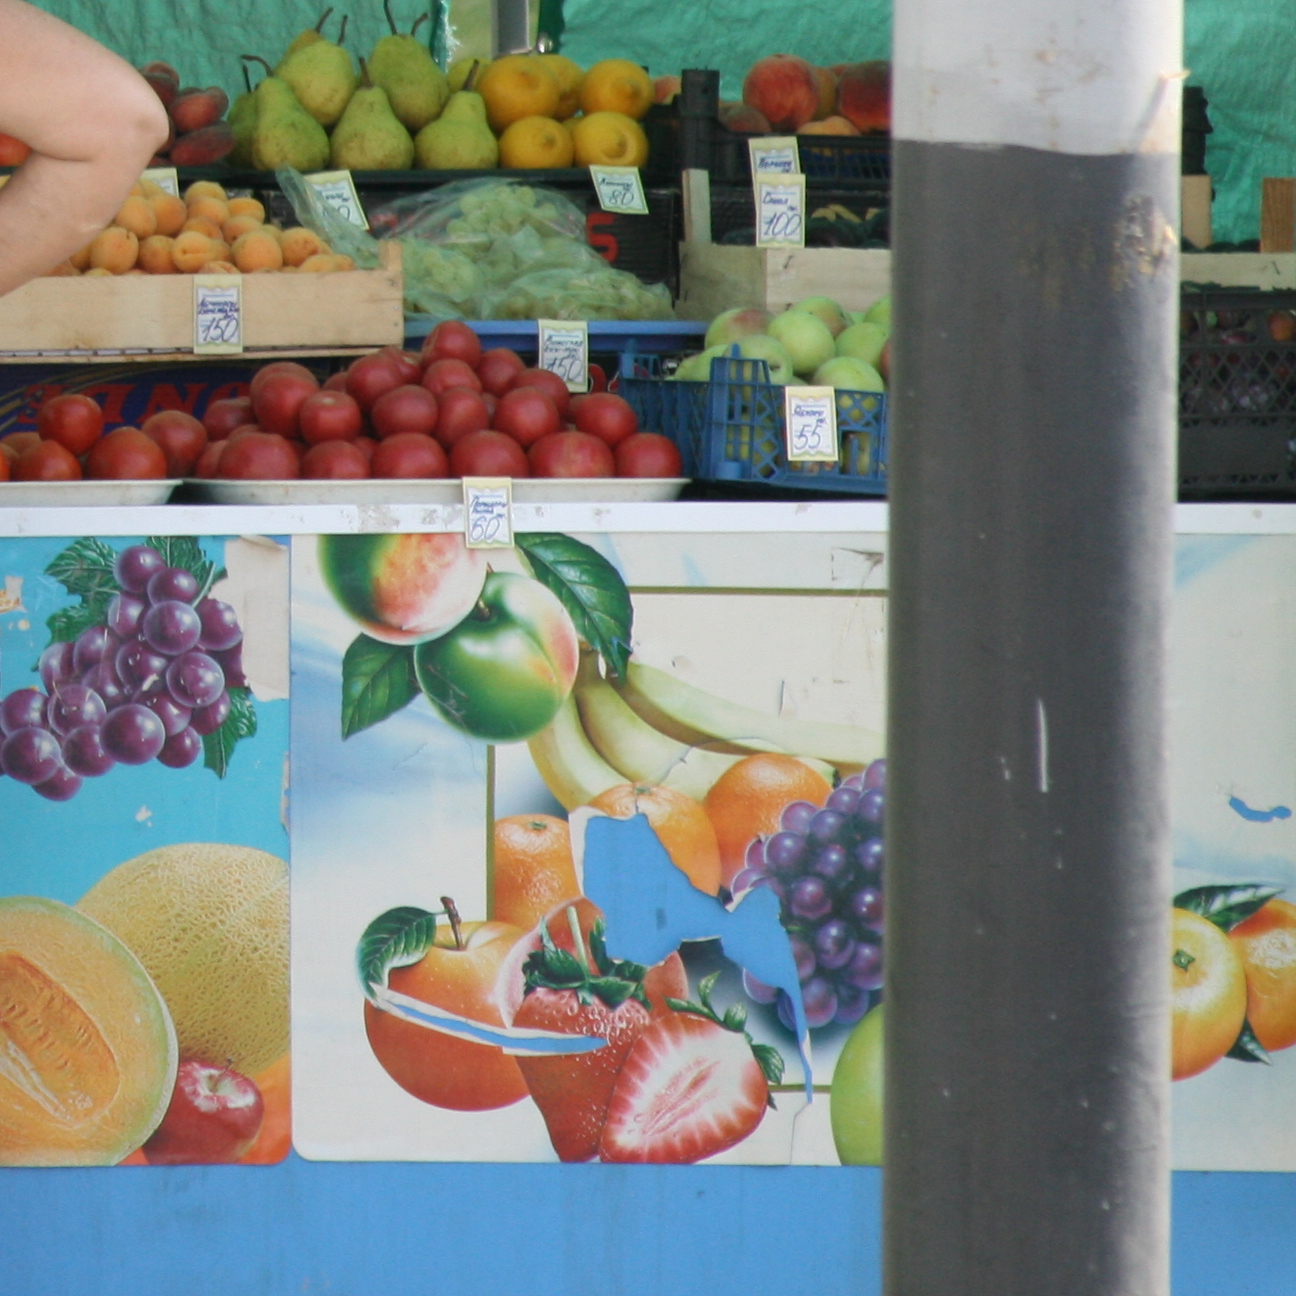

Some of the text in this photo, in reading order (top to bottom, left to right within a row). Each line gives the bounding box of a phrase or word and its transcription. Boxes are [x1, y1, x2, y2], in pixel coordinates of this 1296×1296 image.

[609, 190, 634, 205] 80
[763, 212, 801, 237] 100
[202, 316, 238, 342] 150
[794, 424, 822, 450] 55
[471, 516, 500, 541] 60
